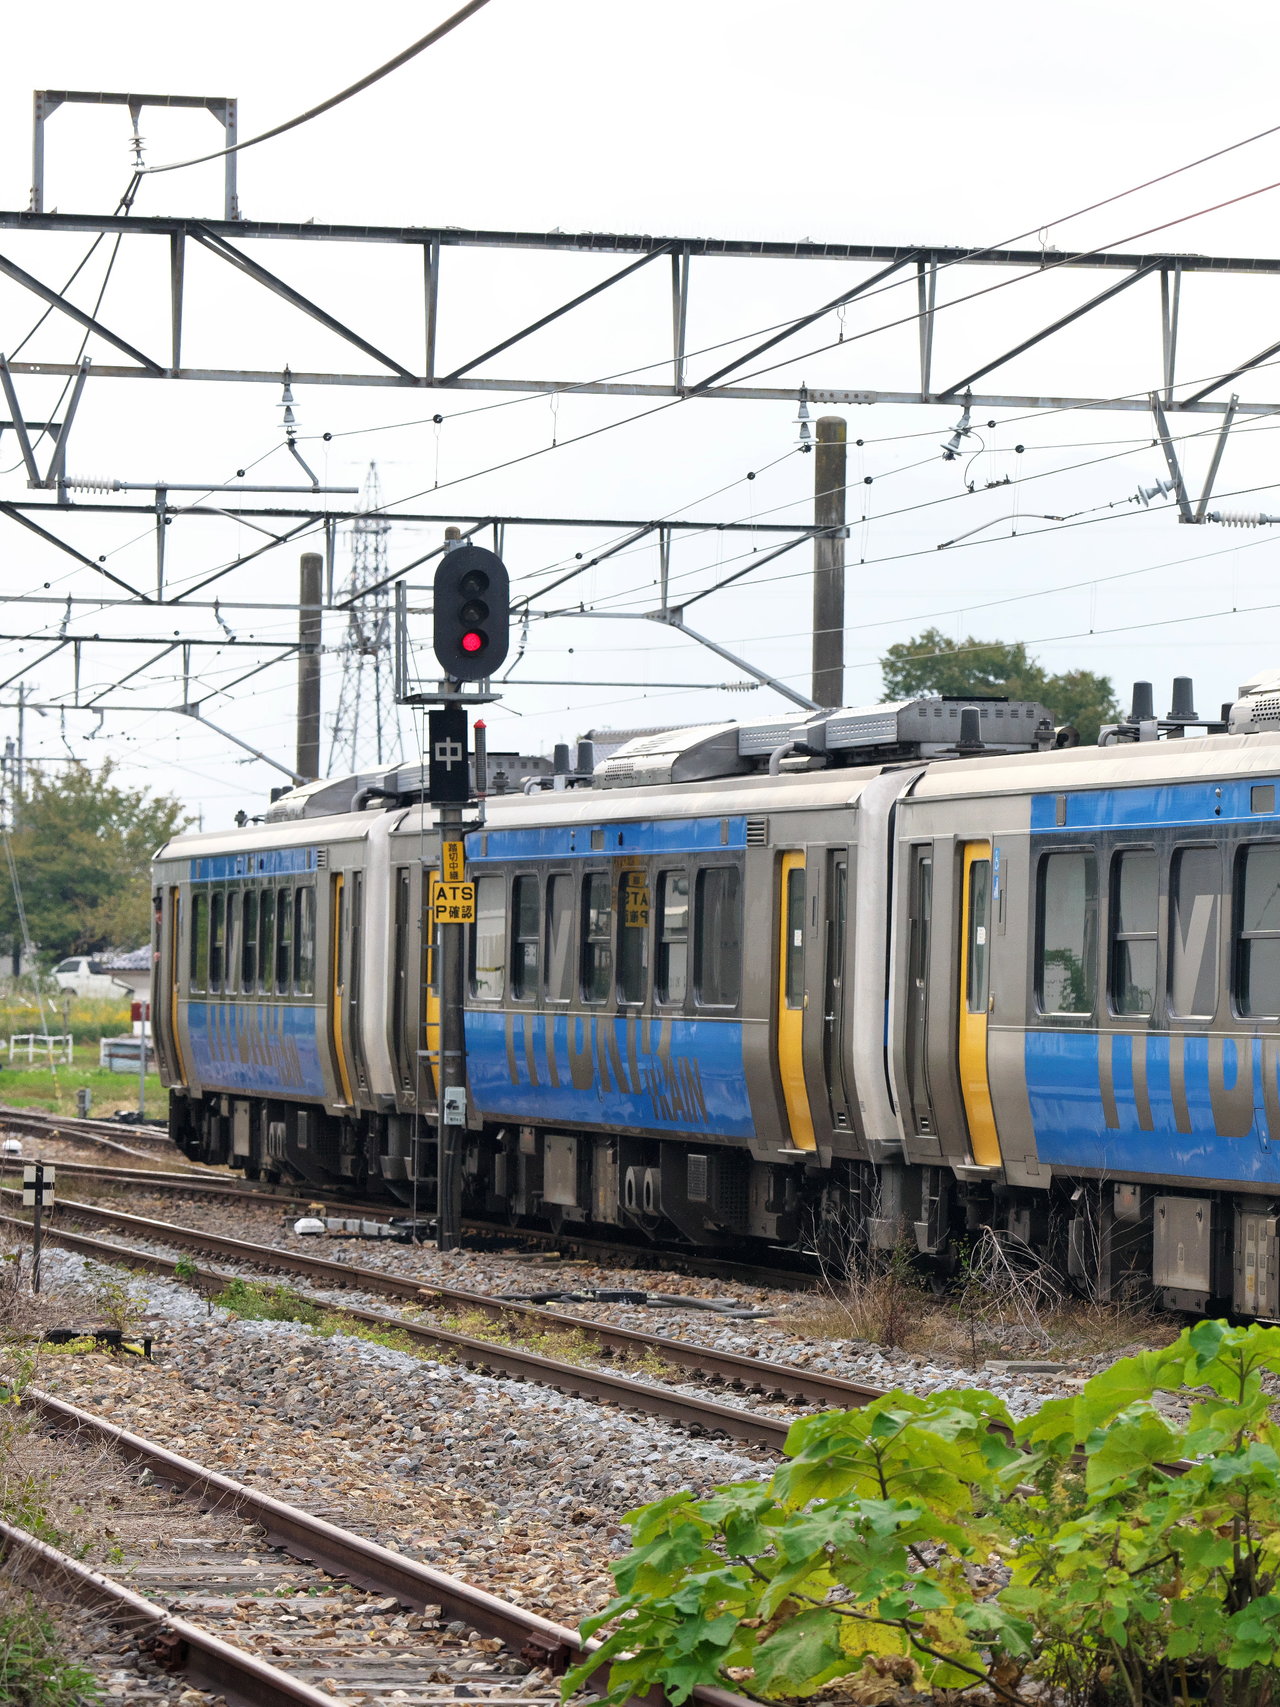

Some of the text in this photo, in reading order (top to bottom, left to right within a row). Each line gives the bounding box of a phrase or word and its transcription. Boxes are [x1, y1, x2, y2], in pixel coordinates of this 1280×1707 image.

[435, 737, 462, 771] 中
[436, 886, 473, 901] ATS
[436, 905, 473, 919] P確認
